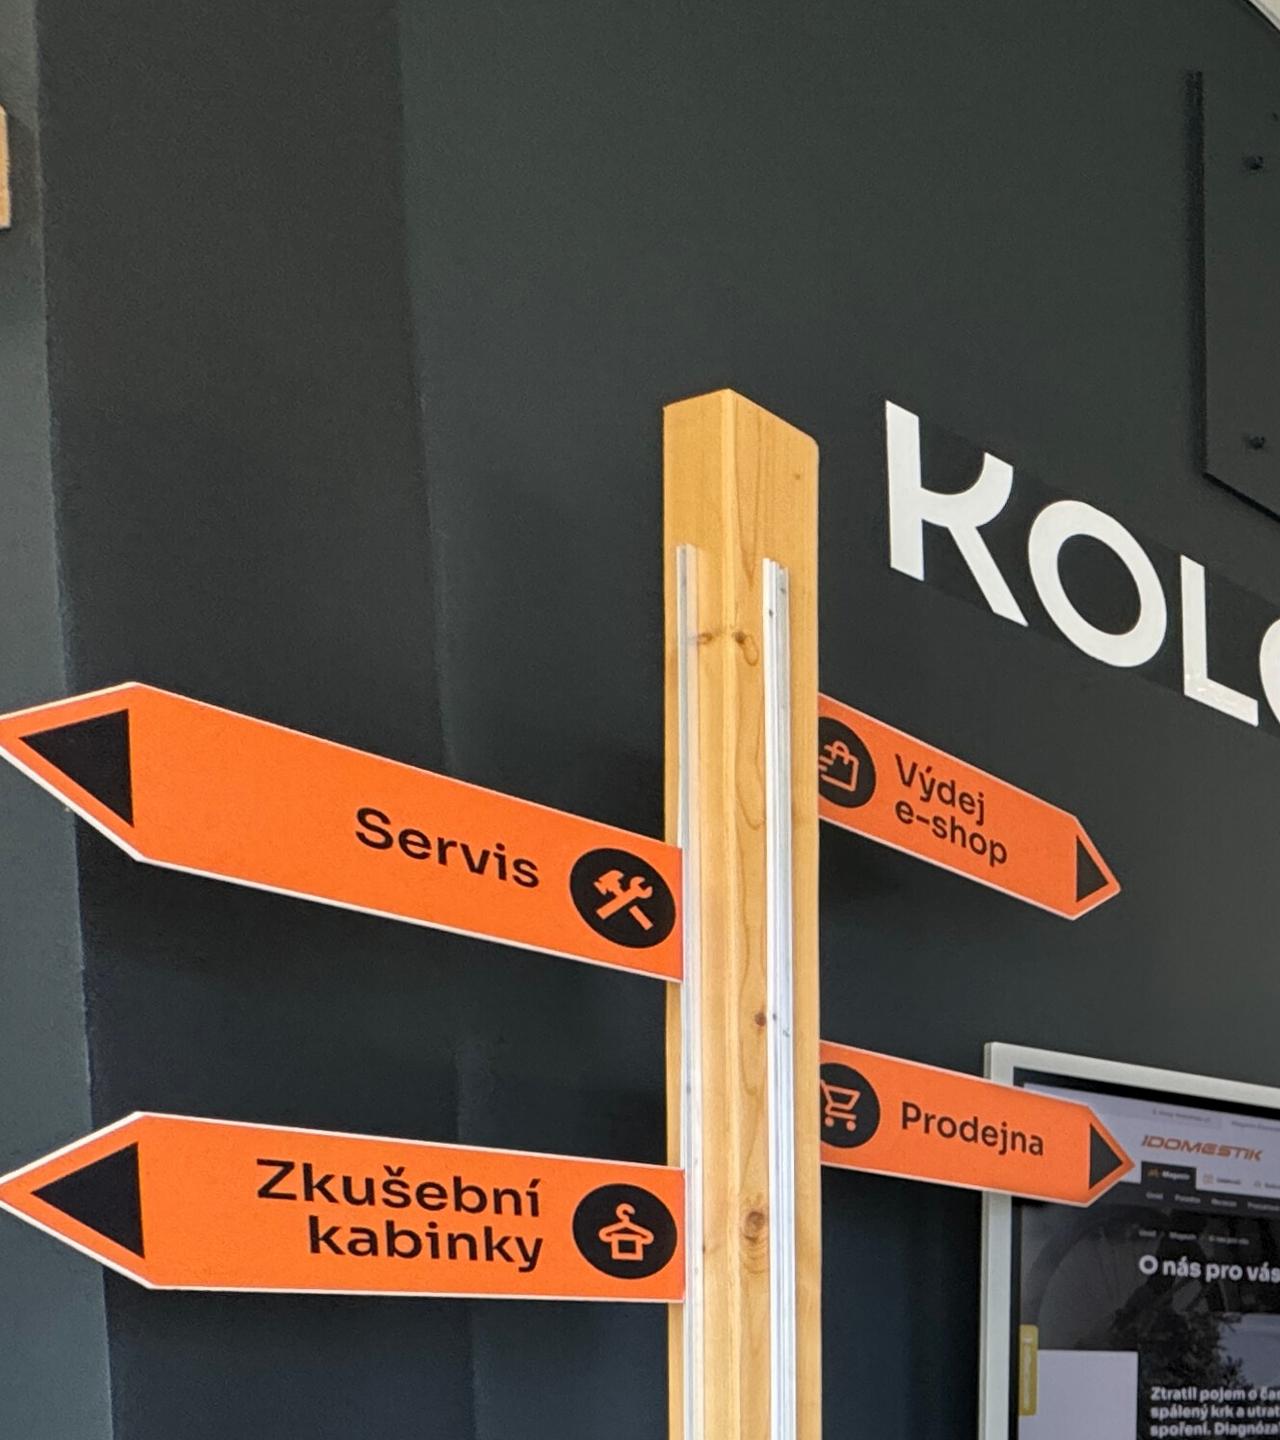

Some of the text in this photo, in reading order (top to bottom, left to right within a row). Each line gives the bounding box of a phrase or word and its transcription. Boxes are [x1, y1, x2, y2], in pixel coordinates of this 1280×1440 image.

[893, 751, 986, 826] Výdej
[356, 807, 541, 889] Servis
[895, 801, 1009, 868] e-shop
[900, 1101, 1045, 1160] Prodejna
[1141, 1135, 1263, 1162] IDOMESTIK
[256, 1158, 542, 1219] Zkušební
[308, 1214, 544, 1273] kabinky
[1139, 1255, 1158, 1275] O
[1163, 1256, 1201, 1278] nás
[1205, 1262, 1243, 1282] pro
[1150, 1386, 1198, 1401] Ztratil
[1200, 1387, 1246, 1402] pojem
[1248, 1390, 1257, 1401] o
[1150, 1403, 1209, 1421] spálený
[1211, 1404, 1234, 1418] krk
[1236, 1407, 1245, 1418] a
[1150, 1421, 1211, 1438] spoření.
